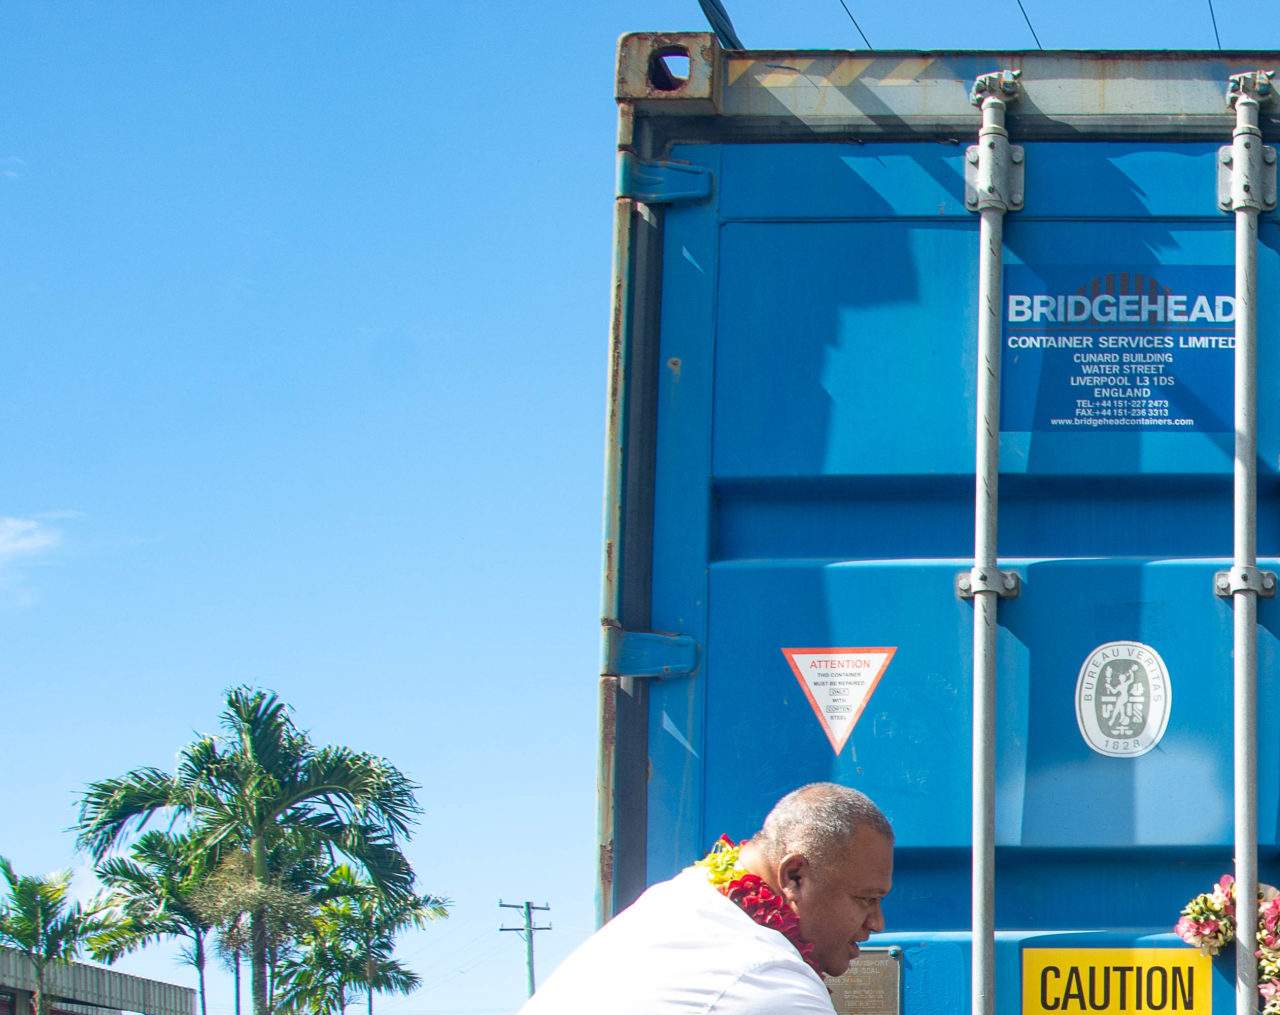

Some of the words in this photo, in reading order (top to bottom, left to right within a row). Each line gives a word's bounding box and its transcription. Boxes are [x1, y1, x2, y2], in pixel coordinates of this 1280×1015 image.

[1008, 294, 1236, 323] BRIDGEHEAD
[1007, 336, 1094, 349] CONTAINER
[1098, 336, 1174, 349] SERVICES
[1179, 336, 1236, 349] LIMITED
[1073, 353, 1120, 363] CUNARD
[1122, 353, 1173, 363] BUILDING
[1081, 364, 1120, 374] WATER
[1123, 364, 1165, 374] STREET
[1070, 376, 1131, 386] LIVERPOOL
[1136, 376, 1150, 386] L3
[1153, 376, 1175, 386] 1DS
[1094, 388, 1151, 398] ENGLAND
[1147, 399, 1169, 408] 2473
[1050, 417, 1194, 427] www.bridgeheadcontainers.com
[808, 659, 871, 669] ATTENTION
[1083, 647, 1120, 702] BUREAU
[1126, 647, 1163, 703] VERITAS
[1104, 739, 1141, 751] 1828
[1040, 965, 1194, 1011] CAUTION
